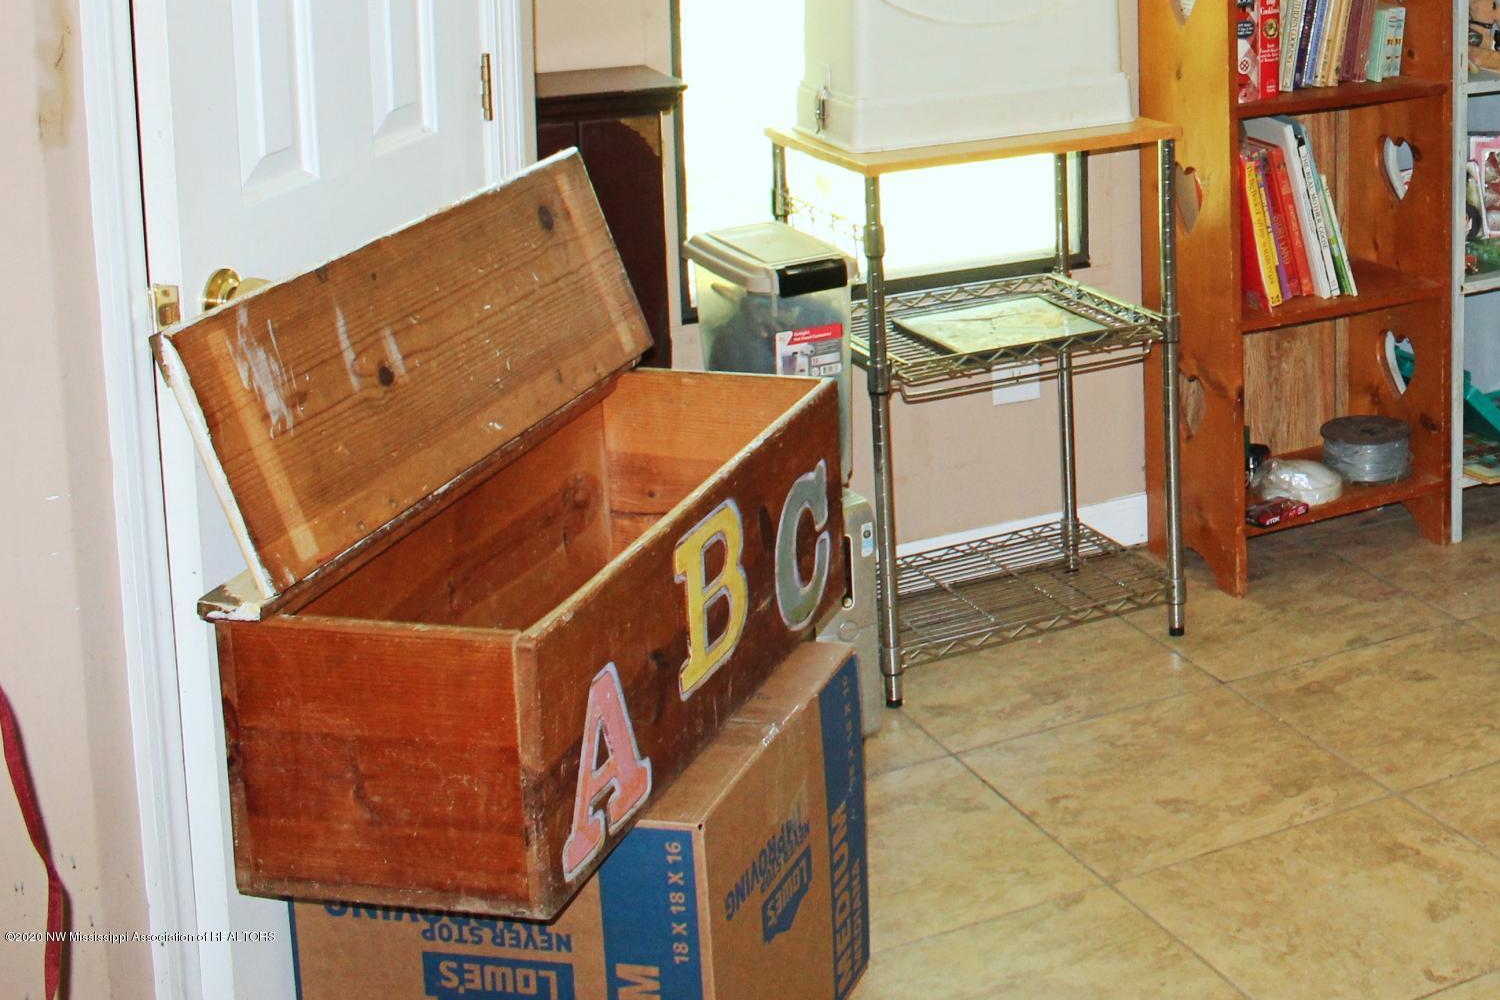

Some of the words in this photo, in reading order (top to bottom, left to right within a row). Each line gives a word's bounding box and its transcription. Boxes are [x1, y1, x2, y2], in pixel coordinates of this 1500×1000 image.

[1302, 154, 1310, 168] THE
[1305, 170, 1314, 187] REAL
[1309, 188, 1322, 223] MOTHER
[1317, 223, 1329, 249] GOOSE
[1266, 515, 1280, 526] TDK
[775, 459, 829, 632] C
[672, 498, 749, 700] B
[562, 661, 653, 883] A
[664, 841, 682, 865] 16
[667, 871, 684, 886] X
[669, 892, 686, 915] 18
[830, 800, 851, 998] MEDIUM
[421, 922, 484, 945] STOP
[490, 926, 573, 953] NEVER
[671, 922, 689, 936] X
[672, 940, 690, 964] 18
[439, 959, 558, 1000] LOWE'S
